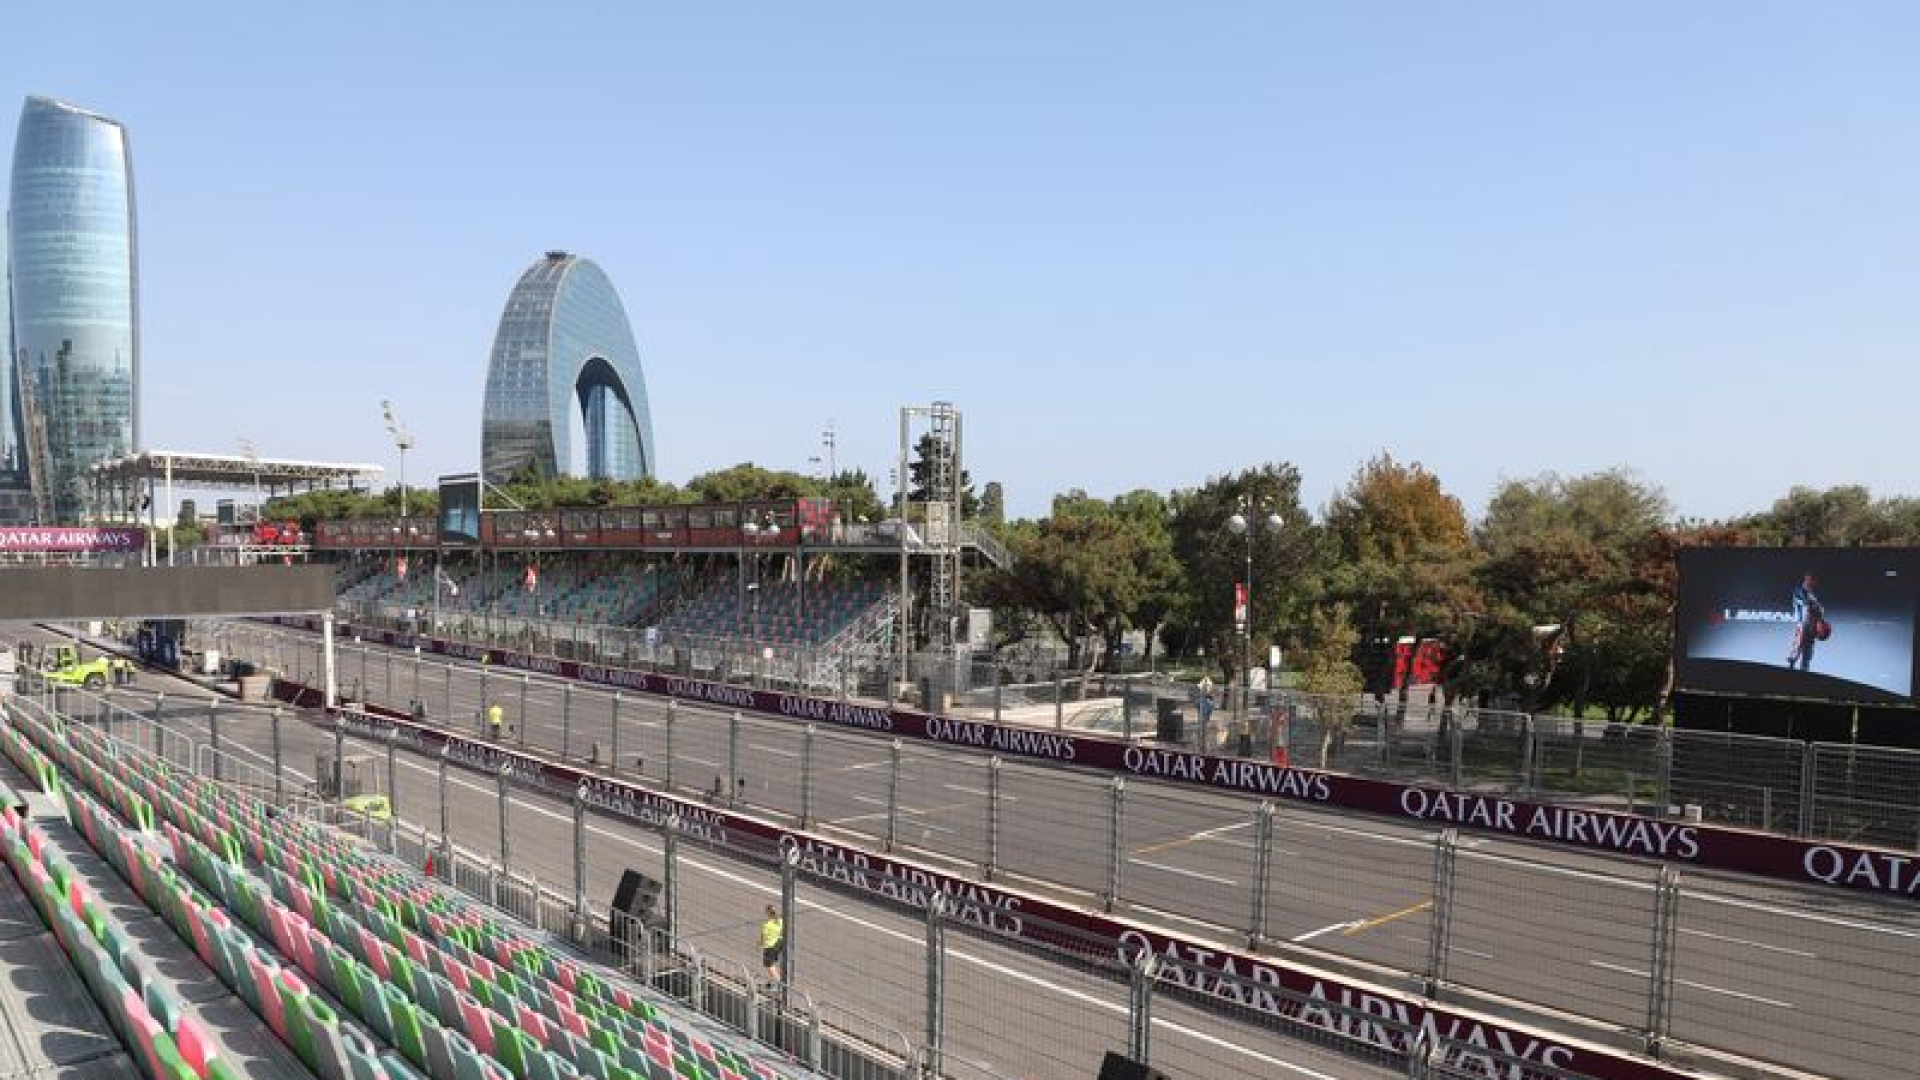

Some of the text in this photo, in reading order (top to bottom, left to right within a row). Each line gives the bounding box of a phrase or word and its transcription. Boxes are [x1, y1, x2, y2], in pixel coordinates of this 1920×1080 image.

[926, 718, 1076, 759] QATAR AIRWAYS
[1124, 748, 1330, 800] QATAR AIRWAYS
[1400, 787, 1700, 858] QATAR AIRWAYS
[1117, 930, 1279, 1014] QATAR
